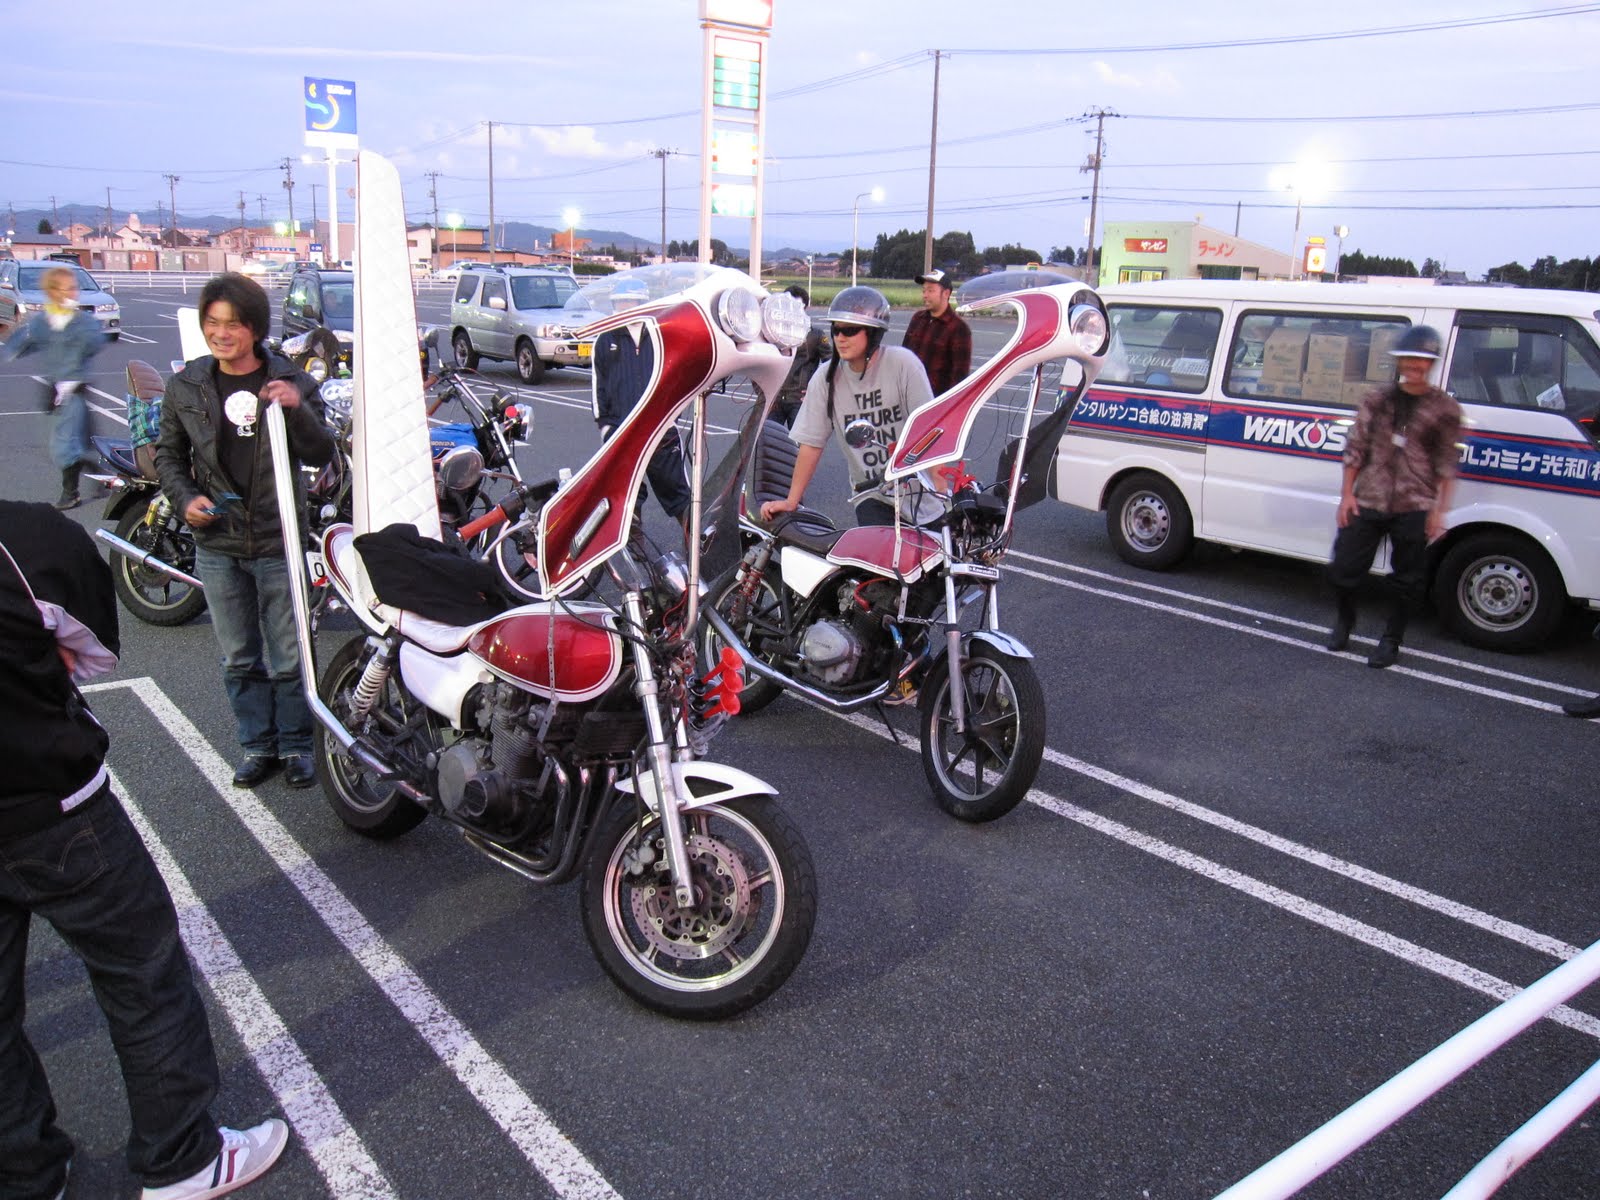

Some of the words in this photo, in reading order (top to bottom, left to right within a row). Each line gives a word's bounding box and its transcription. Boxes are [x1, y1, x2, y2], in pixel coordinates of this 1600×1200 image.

[1198, 240, 1235, 257] ラーメン
[854, 389, 883, 410] THE
[1243, 414, 1348, 453] WAKO'S
[863, 450, 890, 468] OU
